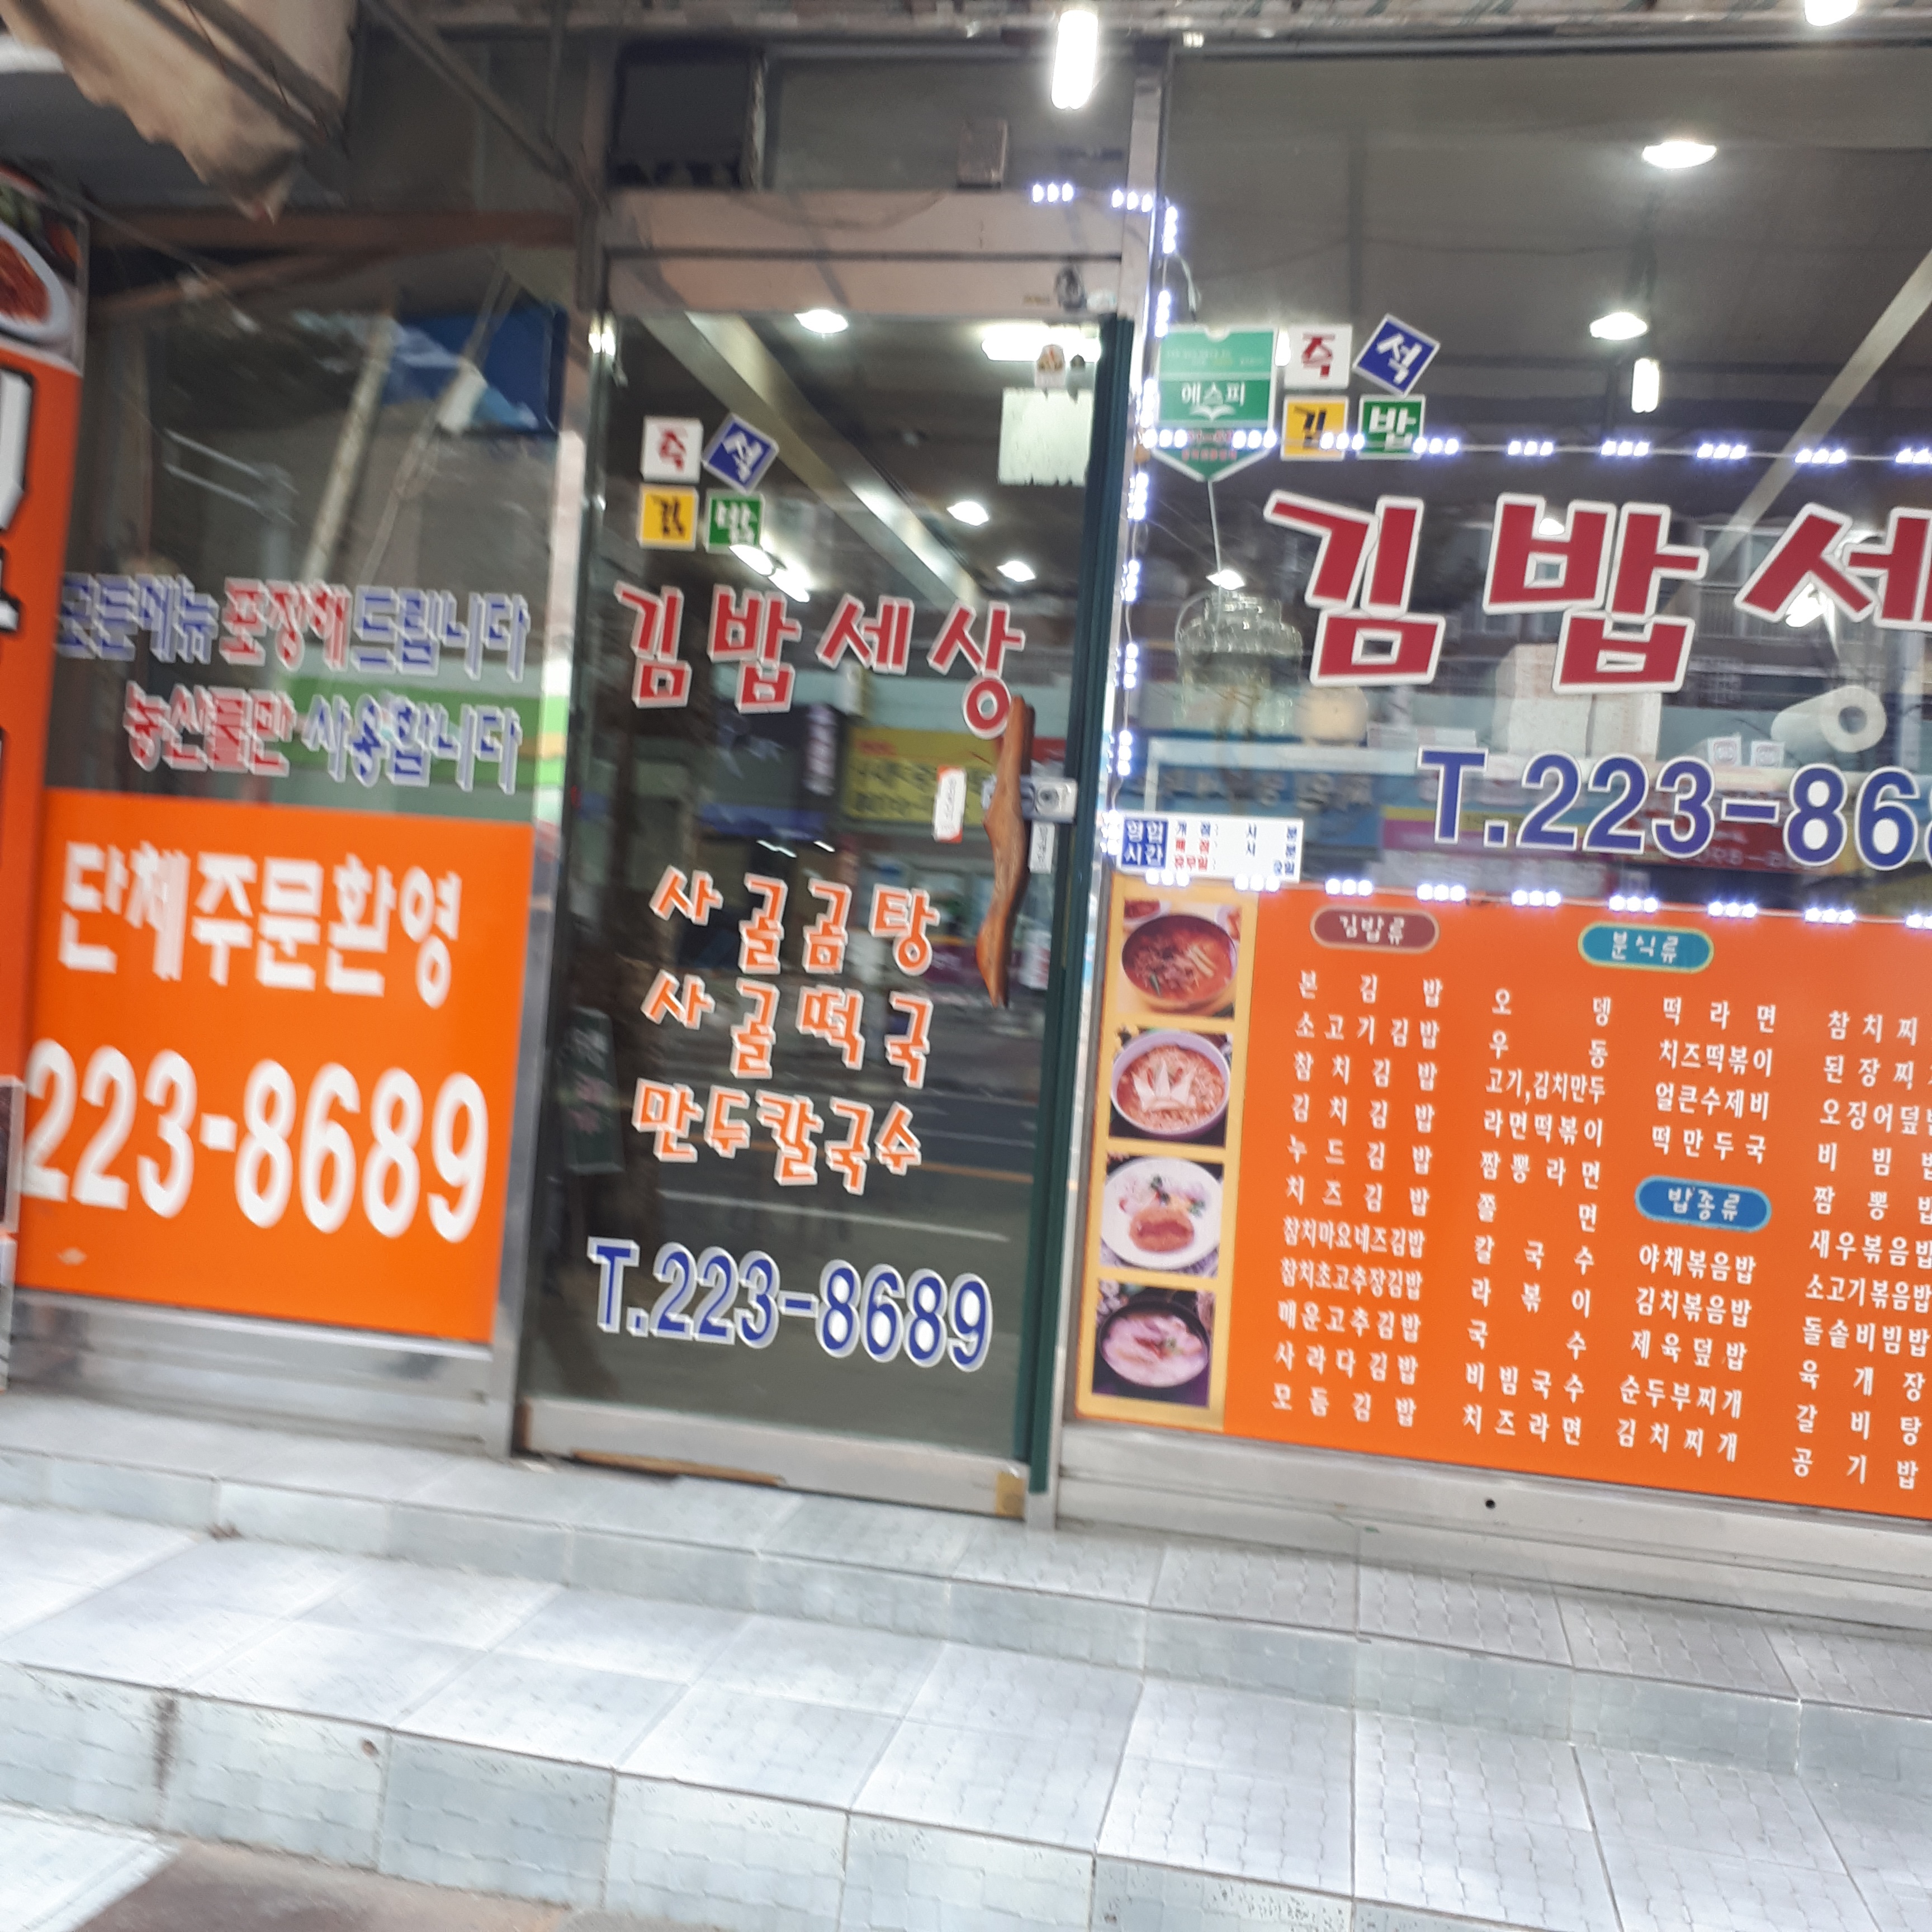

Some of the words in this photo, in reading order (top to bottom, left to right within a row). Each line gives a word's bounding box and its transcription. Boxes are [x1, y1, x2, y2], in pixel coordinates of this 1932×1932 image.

[350, 585, 531, 683] 드립니다
[302, 692, 523, 795] 사용합니다
[1418, 745, 1932, 871] T.223-86
[58, 840, 462, 1010] 단체주문환영
[1339, 914, 1405, 944] 김밥류
[1659, 1039, 1773, 1078] 치즈떡볶이
[1655, 1082, 1770, 1121] 얼큰수제비
[1820, 1098, 1932, 1136] 오징어덮
[20, 1038, 490, 1244] 223-8689
[631, 1078, 922, 1195] 만두칼국수
[1484, 1109, 1603, 1148] 라면떡볶이
[1652, 1125, 1767, 1165] 떡만두국
[1668, 1187, 1741, 1222] 밥종류
[1283, 1216, 1426, 1258] 참치마요네즈김밥
[1281, 1257, 1423, 1301] 참치초고추장김밥
[1639, 1244, 1756, 1285] 야채볶음밥
[588, 1236, 993, 1372] T.223-8689
[1636, 1287, 1752, 1329] 김치볶음밥
[1805, 1273, 1932, 1314] 소고기볶음밥
[1278, 1300, 1420, 1343] 매운고추김밥
[1274, 1341, 1418, 1385] 사라다김밥
[1631, 1329, 1748, 1372] 제육덮밥
[1465, 1362, 1585, 1404] 비빔국수
[1620, 1375, 1743, 1420] 순두부찌개
[1463, 1404, 1582, 1446] 치즈라면
[1616, 1418, 1738, 1463] 김치찌개
